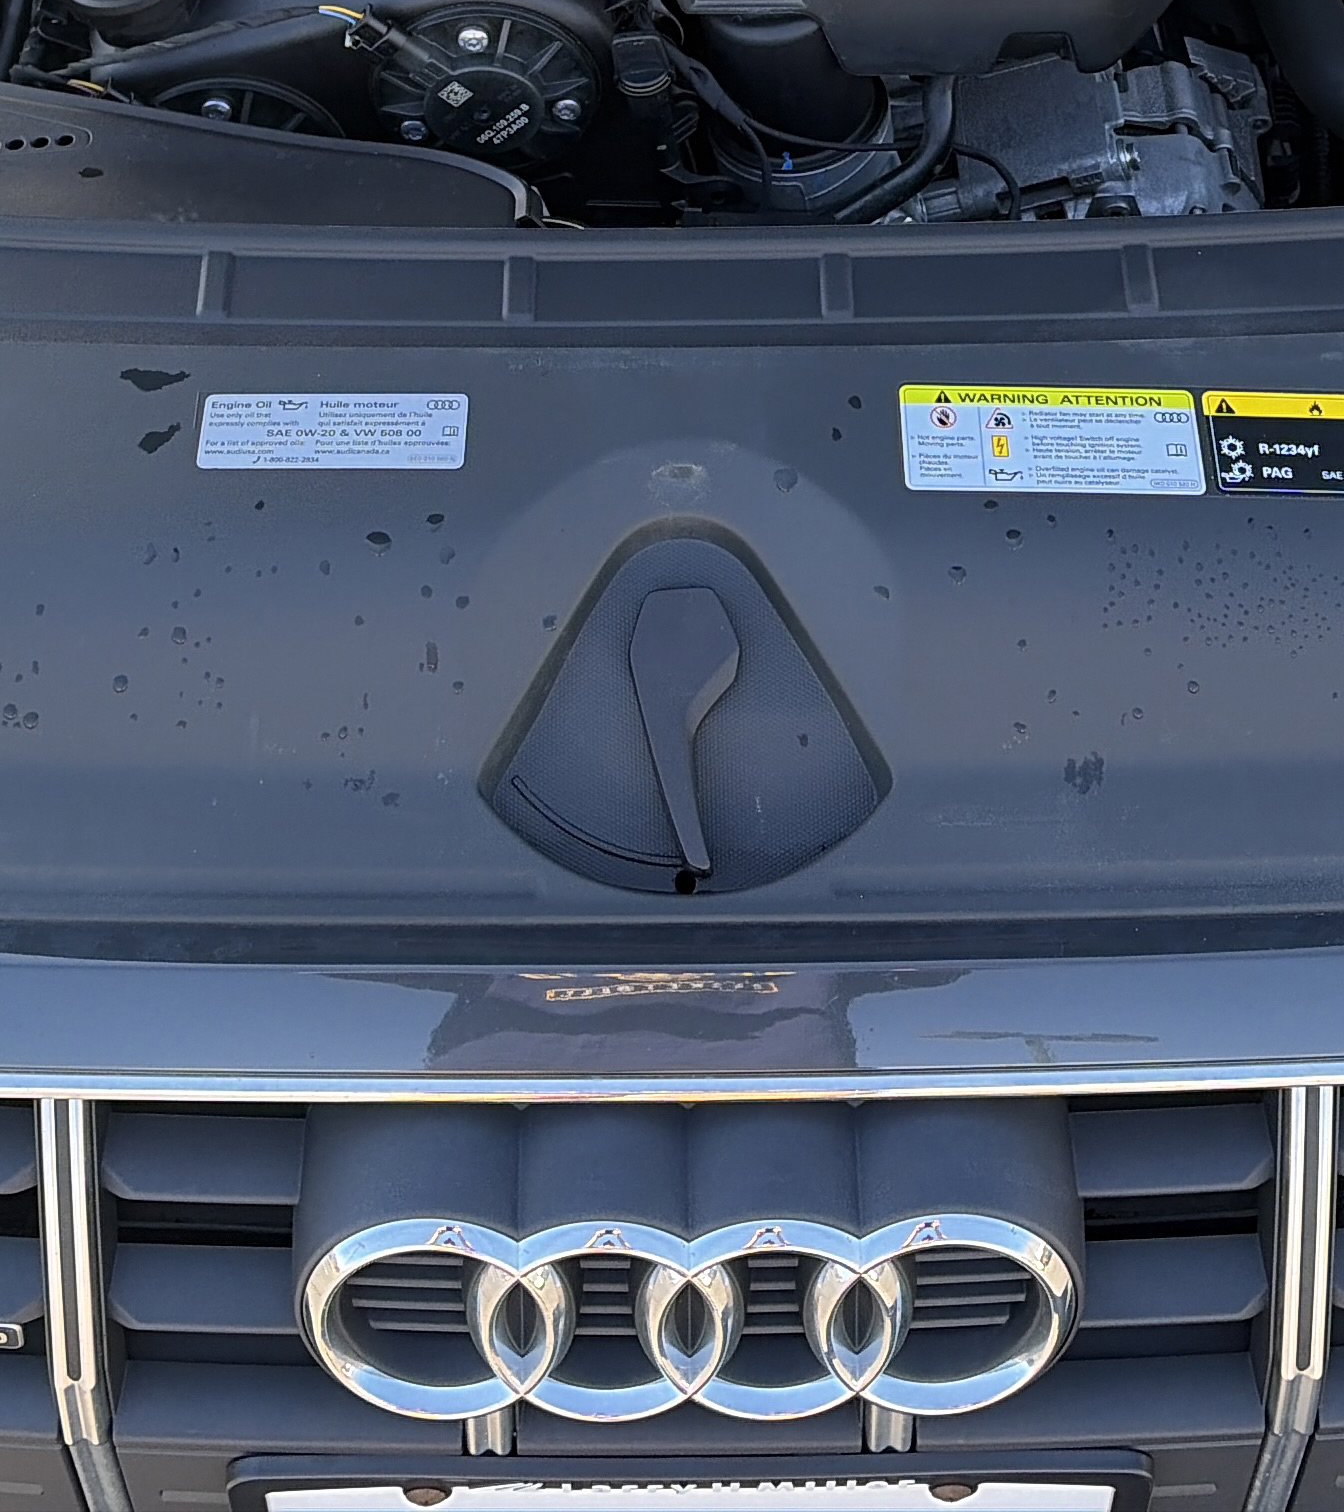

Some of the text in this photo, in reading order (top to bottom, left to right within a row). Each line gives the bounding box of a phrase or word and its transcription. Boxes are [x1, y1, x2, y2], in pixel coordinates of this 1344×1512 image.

[957, 392, 1162, 407] WARNING ATTENTION
[211, 400, 272, 410] Engine Oil
[319, 400, 400, 409] Huile moteur
[226, 412, 242, 420] only
[208, 420, 245, 428] expressly
[246, 420, 281, 428] complies
[266, 429, 293, 438] SAE
[295, 429, 336, 438] 0W-20
[339, 429, 349, 438] &
[354, 429, 377, 438] VW
[406, 429, 422, 438] 00
[250, 440, 288, 448] approved
[1258, 443, 1320, 458] R-1234yf
[1262, 466, 1293, 479] PAG
[1321, 470, 1343, 481] SAE
